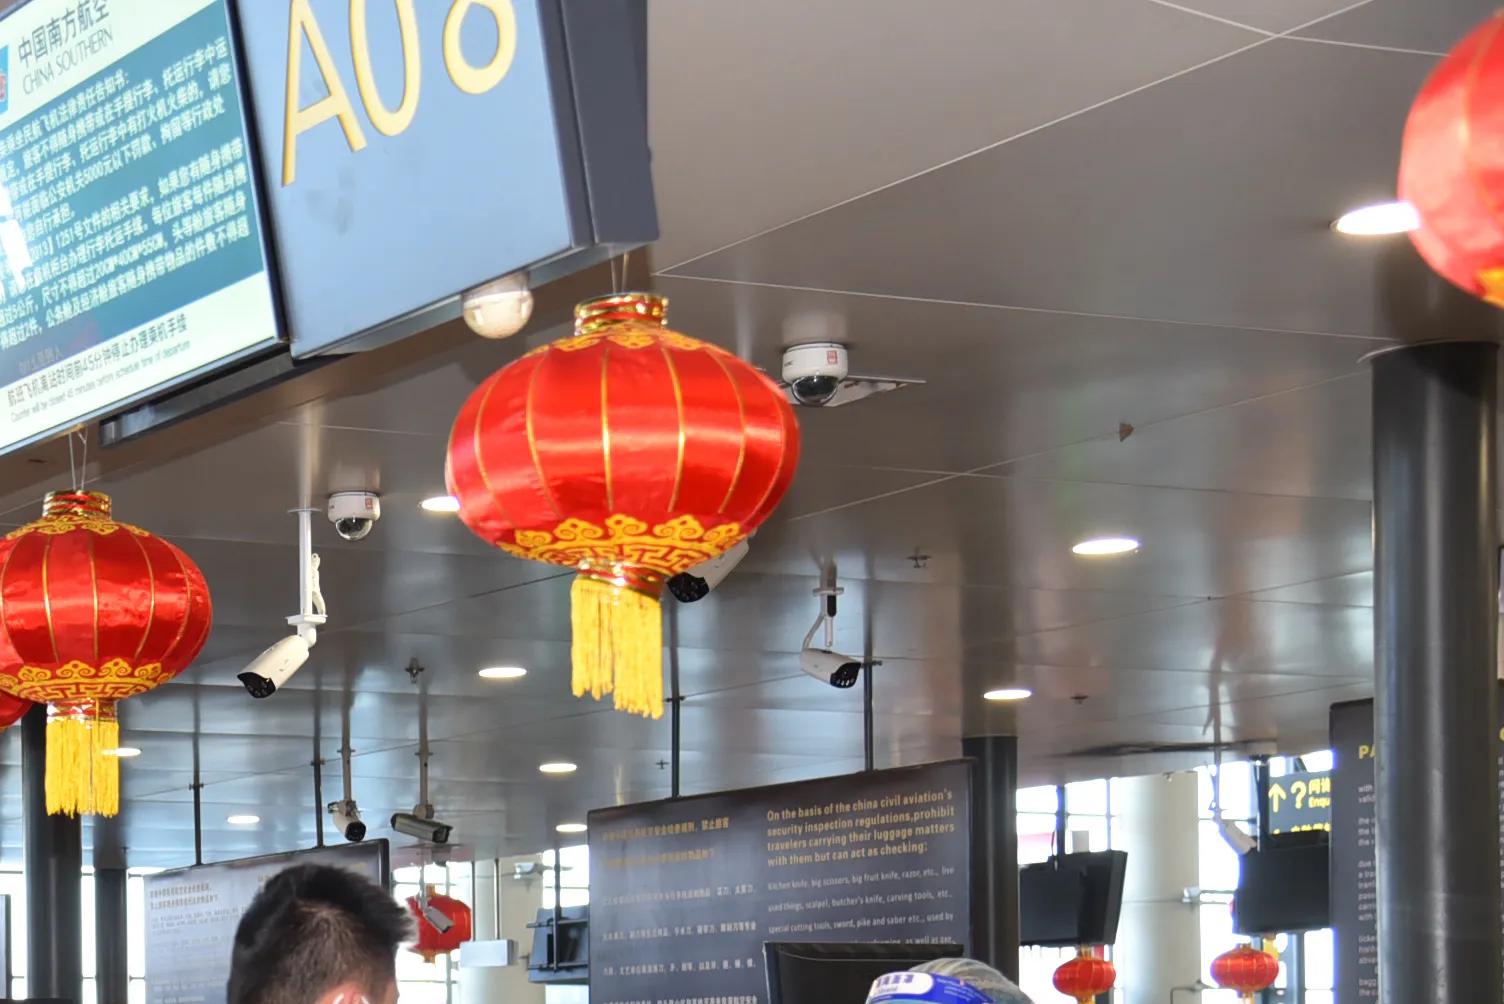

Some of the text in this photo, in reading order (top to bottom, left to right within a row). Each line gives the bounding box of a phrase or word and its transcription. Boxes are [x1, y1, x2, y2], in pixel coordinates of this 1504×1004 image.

[16, 0, 109, 71] 中国南方航空
[21, 22, 114, 97] CHINA SOUTHERN
[766, 808, 779, 822] On
[781, 807, 795, 820] the
[798, 803, 821, 818] basis
[824, 802, 833, 815] of
[835, 801, 850, 813] the
[852, 797, 877, 811] china
[880, 794, 900, 808] civil
[767, 822, 802, 839] security
[804, 816, 852, 835] inspection
[767, 820, 954, 854] travelers carrying their luggage matters
[767, 854, 787, 868] with
[789, 851, 812, 866] them
[814, 849, 830, 863] but
[832, 849, 848, 861] can
[850, 846, 865, 859] act
[867, 846, 878, 856] as
[851, 872, 862, 885] big
[886, 890, 912, 907] carving
[872, 915, 885, 927] and
